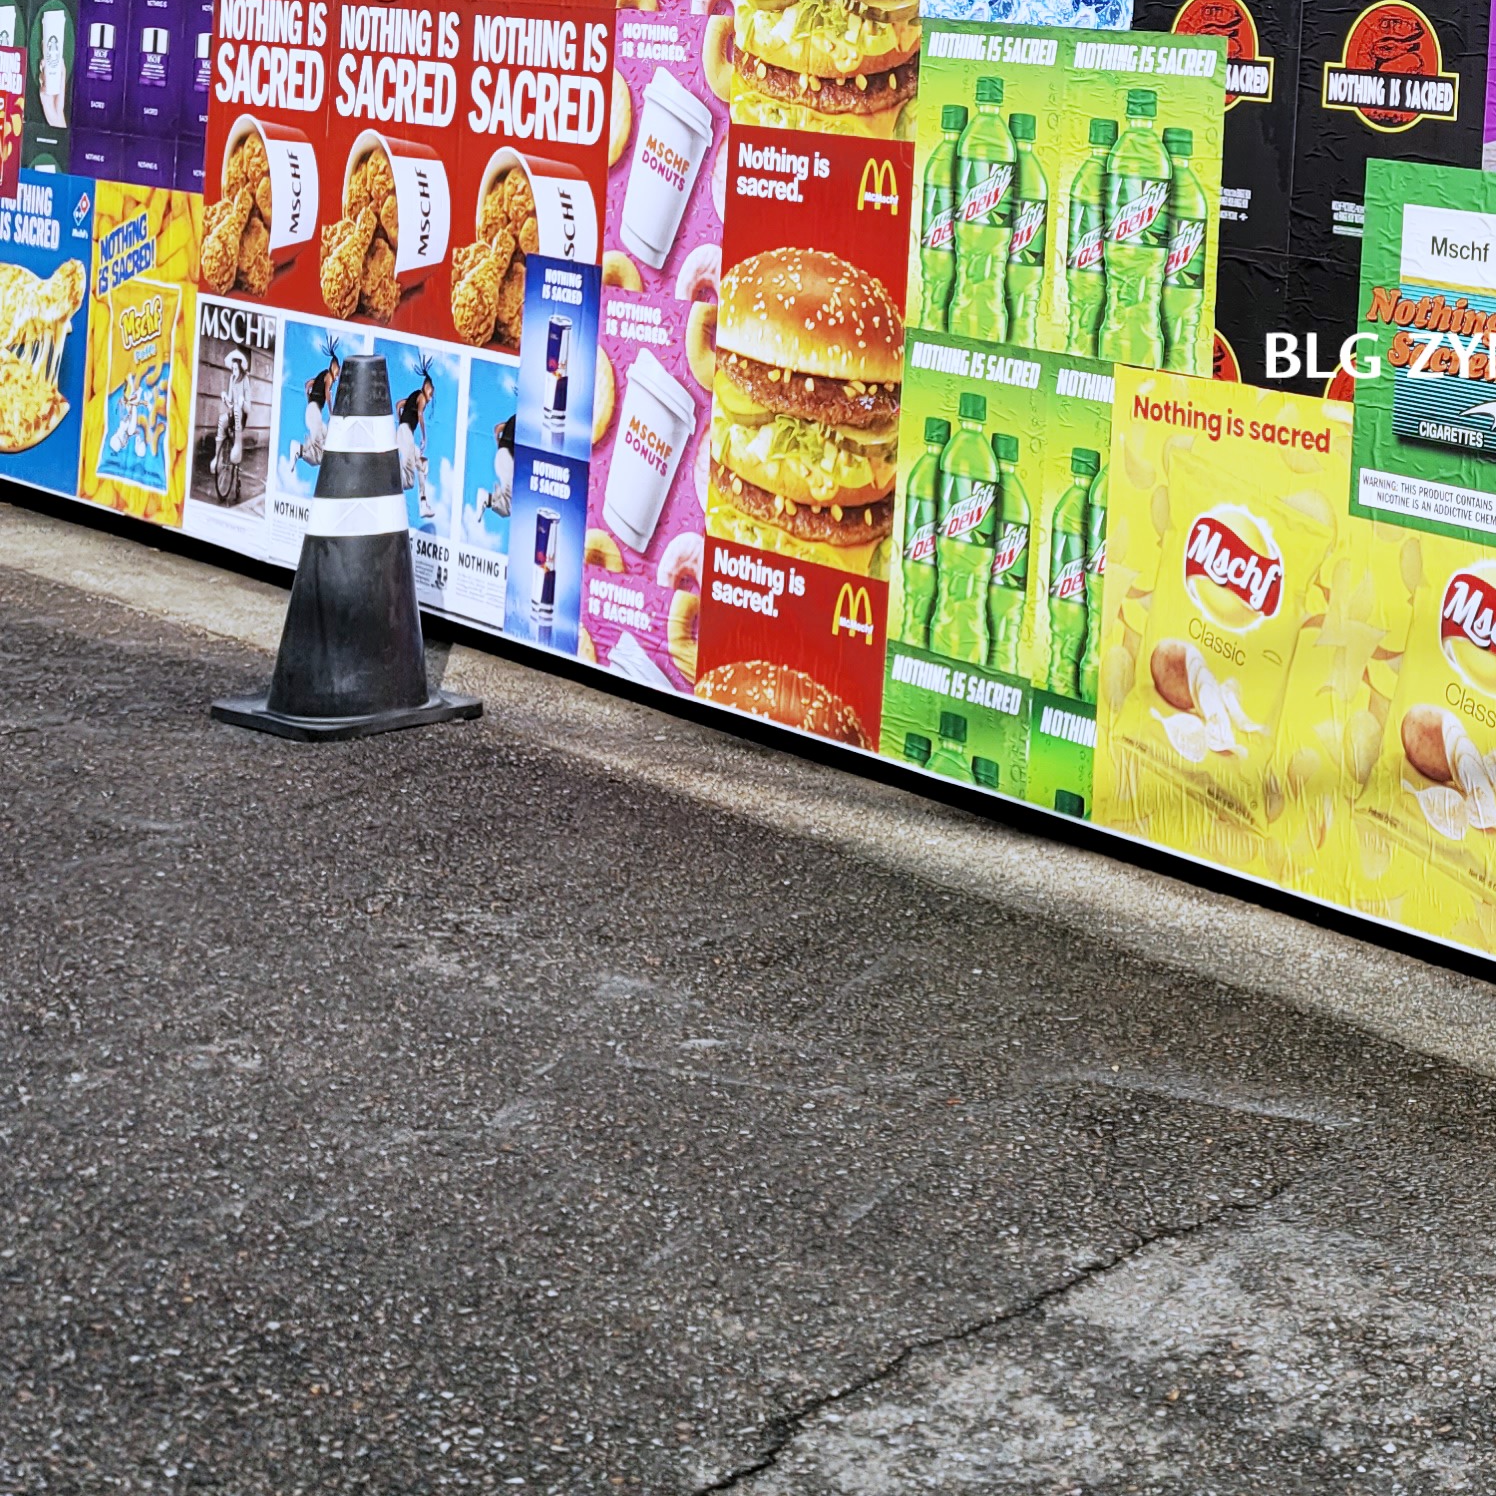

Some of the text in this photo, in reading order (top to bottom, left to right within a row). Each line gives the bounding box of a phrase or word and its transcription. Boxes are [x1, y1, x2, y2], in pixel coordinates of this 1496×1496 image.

[307, 1, 327, 47] IS
[340, 5, 459, 59] NOTHING IS
[473, 15, 607, 73] NOTHING IS
[623, 23, 678, 42] NOTHING
[928, 32, 1058, 66] NOTHING IS SACRED
[1074, 42, 1217, 77] NOTHING IS SACRED
[215, 42, 324, 112] SACRED
[335, 53, 456, 128] SACRED
[1328, 71, 1453, 112] NOTHING IS SACRED
[467, 66, 604, 146] SACRED
[641, 151, 686, 192] DONUTS
[645, 134, 690, 174] MSCHF
[738, 142, 830, 180] Nothing is
[288, 150, 299, 234] MSCHF
[737, 173, 803, 202] sacred.
[14, 214, 59, 250] SACRED
[415, 167, 427, 256] MSCHF
[1431, 236, 1490, 263] Mschf
[542, 284, 582, 305] IS SACRED
[545, 269, 581, 289] NOTHING
[201, 306, 277, 350] MSCHF
[606, 300, 662, 324] NOTHING
[629, 415, 672, 460] MSCHF
[1134, 395, 1331, 454] Nothing is sacred
[1418, 421, 1484, 448] CIGARETTES
[624, 435, 667, 477] DONUTS
[1362, 475, 1398, 491] WARNING:
[1401, 483, 1417, 495] THIS
[1419, 486, 1454, 504] PRODUCT
[1455, 494, 1493, 511] CONTAINS
[1377, 492, 1410, 508] NICOTINE
[1412, 499, 1420, 509] IS
[1421, 501, 1432, 512] AN
[1434, 504, 1473, 521] ADDICTIVE
[459, 552, 499, 577] NOTHING
[713, 547, 805, 597] Nothing is
[1188, 523, 1282, 612] Mschf
[712, 581, 778, 618] sacred.
[1189, 618, 1246, 659] Classic
